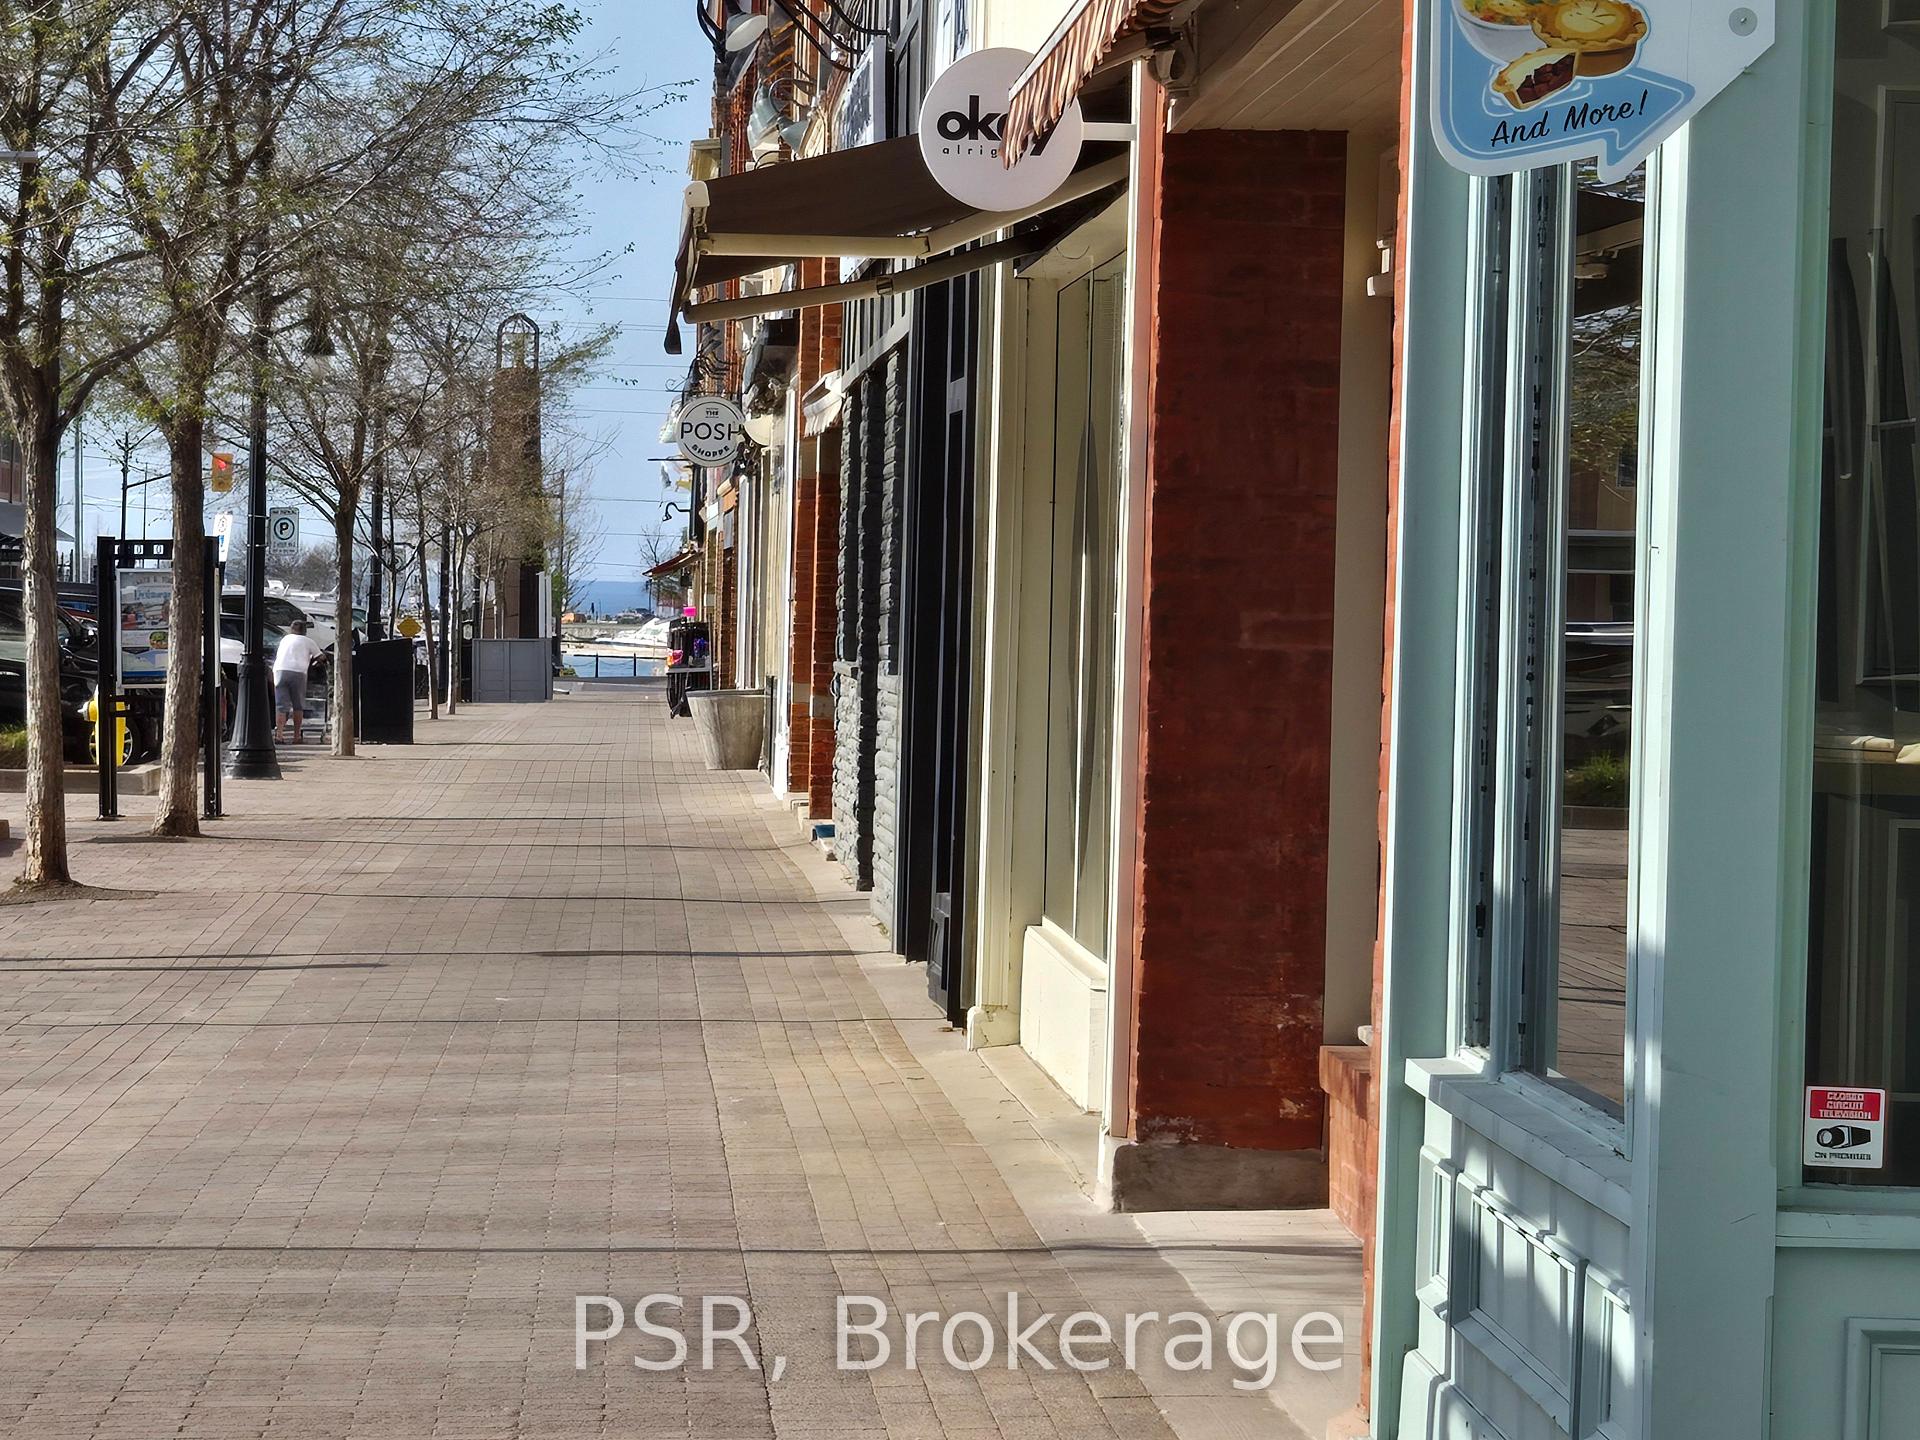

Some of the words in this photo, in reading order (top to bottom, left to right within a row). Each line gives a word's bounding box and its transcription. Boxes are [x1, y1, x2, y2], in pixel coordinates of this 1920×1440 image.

[1491, 111, 1550, 147] And
[1564, 89, 1648, 132] More!
[937, 95, 1063, 156] oky
[681, 422, 742, 441] POSH
[691, 444, 730, 457] SHOPPE
[1827, 1092, 1864, 1101] CLOSED
[1826, 1101, 1863, 1110] CIRCUIT
[1819, 1109, 1871, 1119] TELEVISION
[1814, 1151, 1827, 1159] ON
